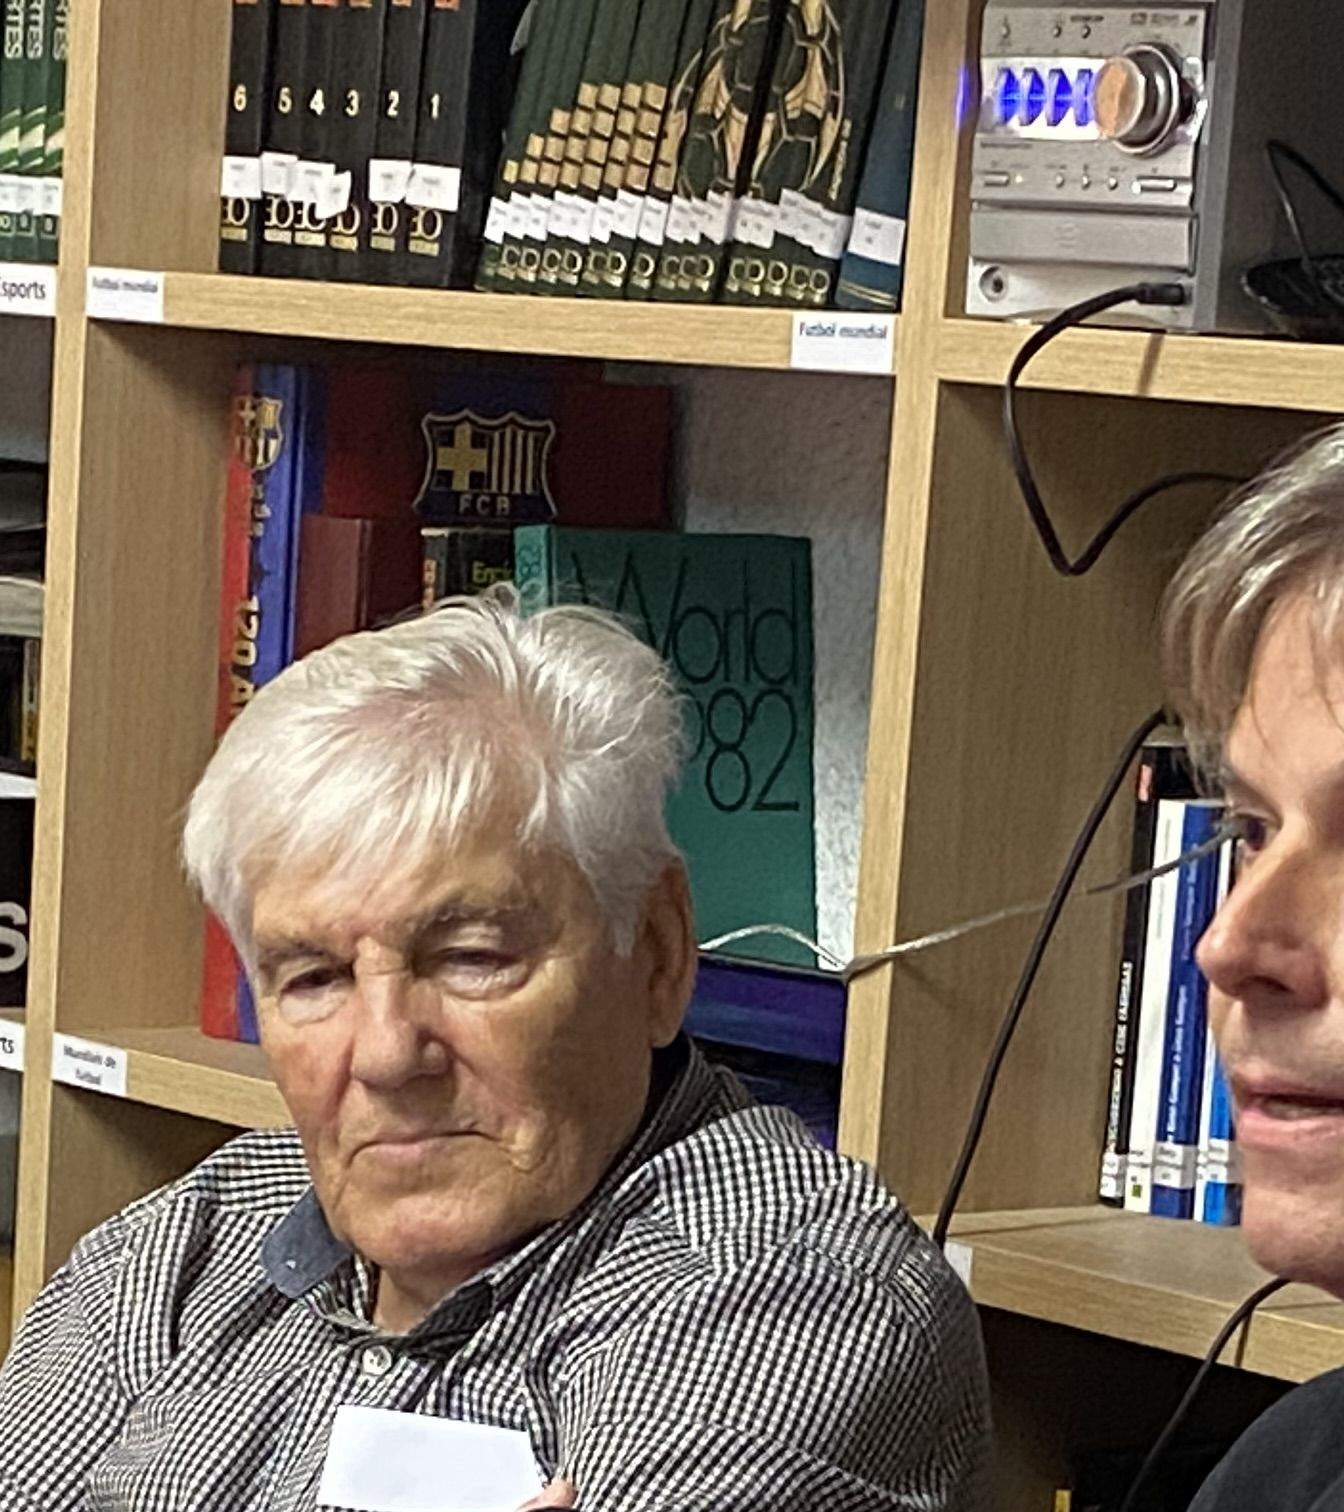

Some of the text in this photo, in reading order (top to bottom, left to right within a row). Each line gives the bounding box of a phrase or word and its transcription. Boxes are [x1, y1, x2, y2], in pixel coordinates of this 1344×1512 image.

[234, 84, 247, 111] 6
[310, 89, 324, 115] 4
[346, 90, 359, 117] 3
[387, 90, 399, 117] 2
[431, 93, 440, 119] 1
